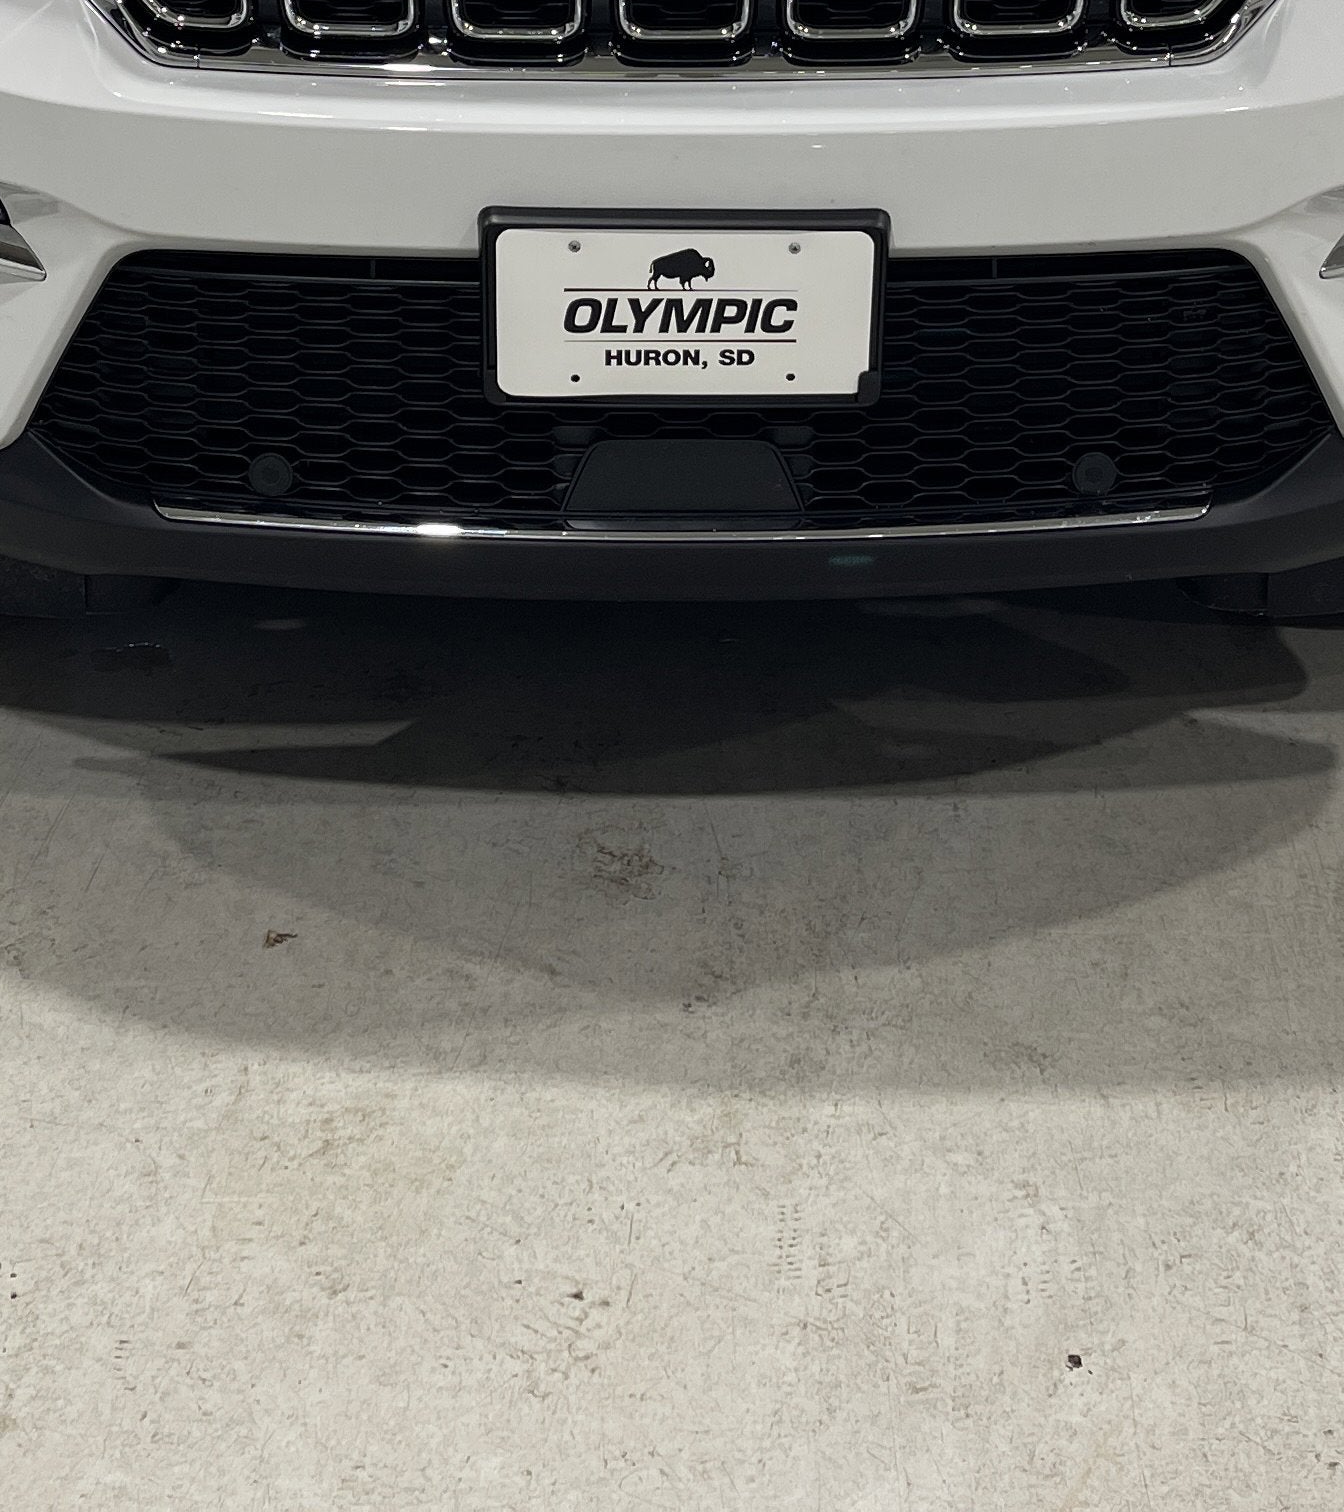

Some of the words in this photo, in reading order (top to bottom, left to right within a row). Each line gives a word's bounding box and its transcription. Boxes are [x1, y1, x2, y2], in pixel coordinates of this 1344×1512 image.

[563, 297, 798, 335] OLYMPIC
[604, 348, 709, 369] HURON,
[718, 348, 756, 367] SD
